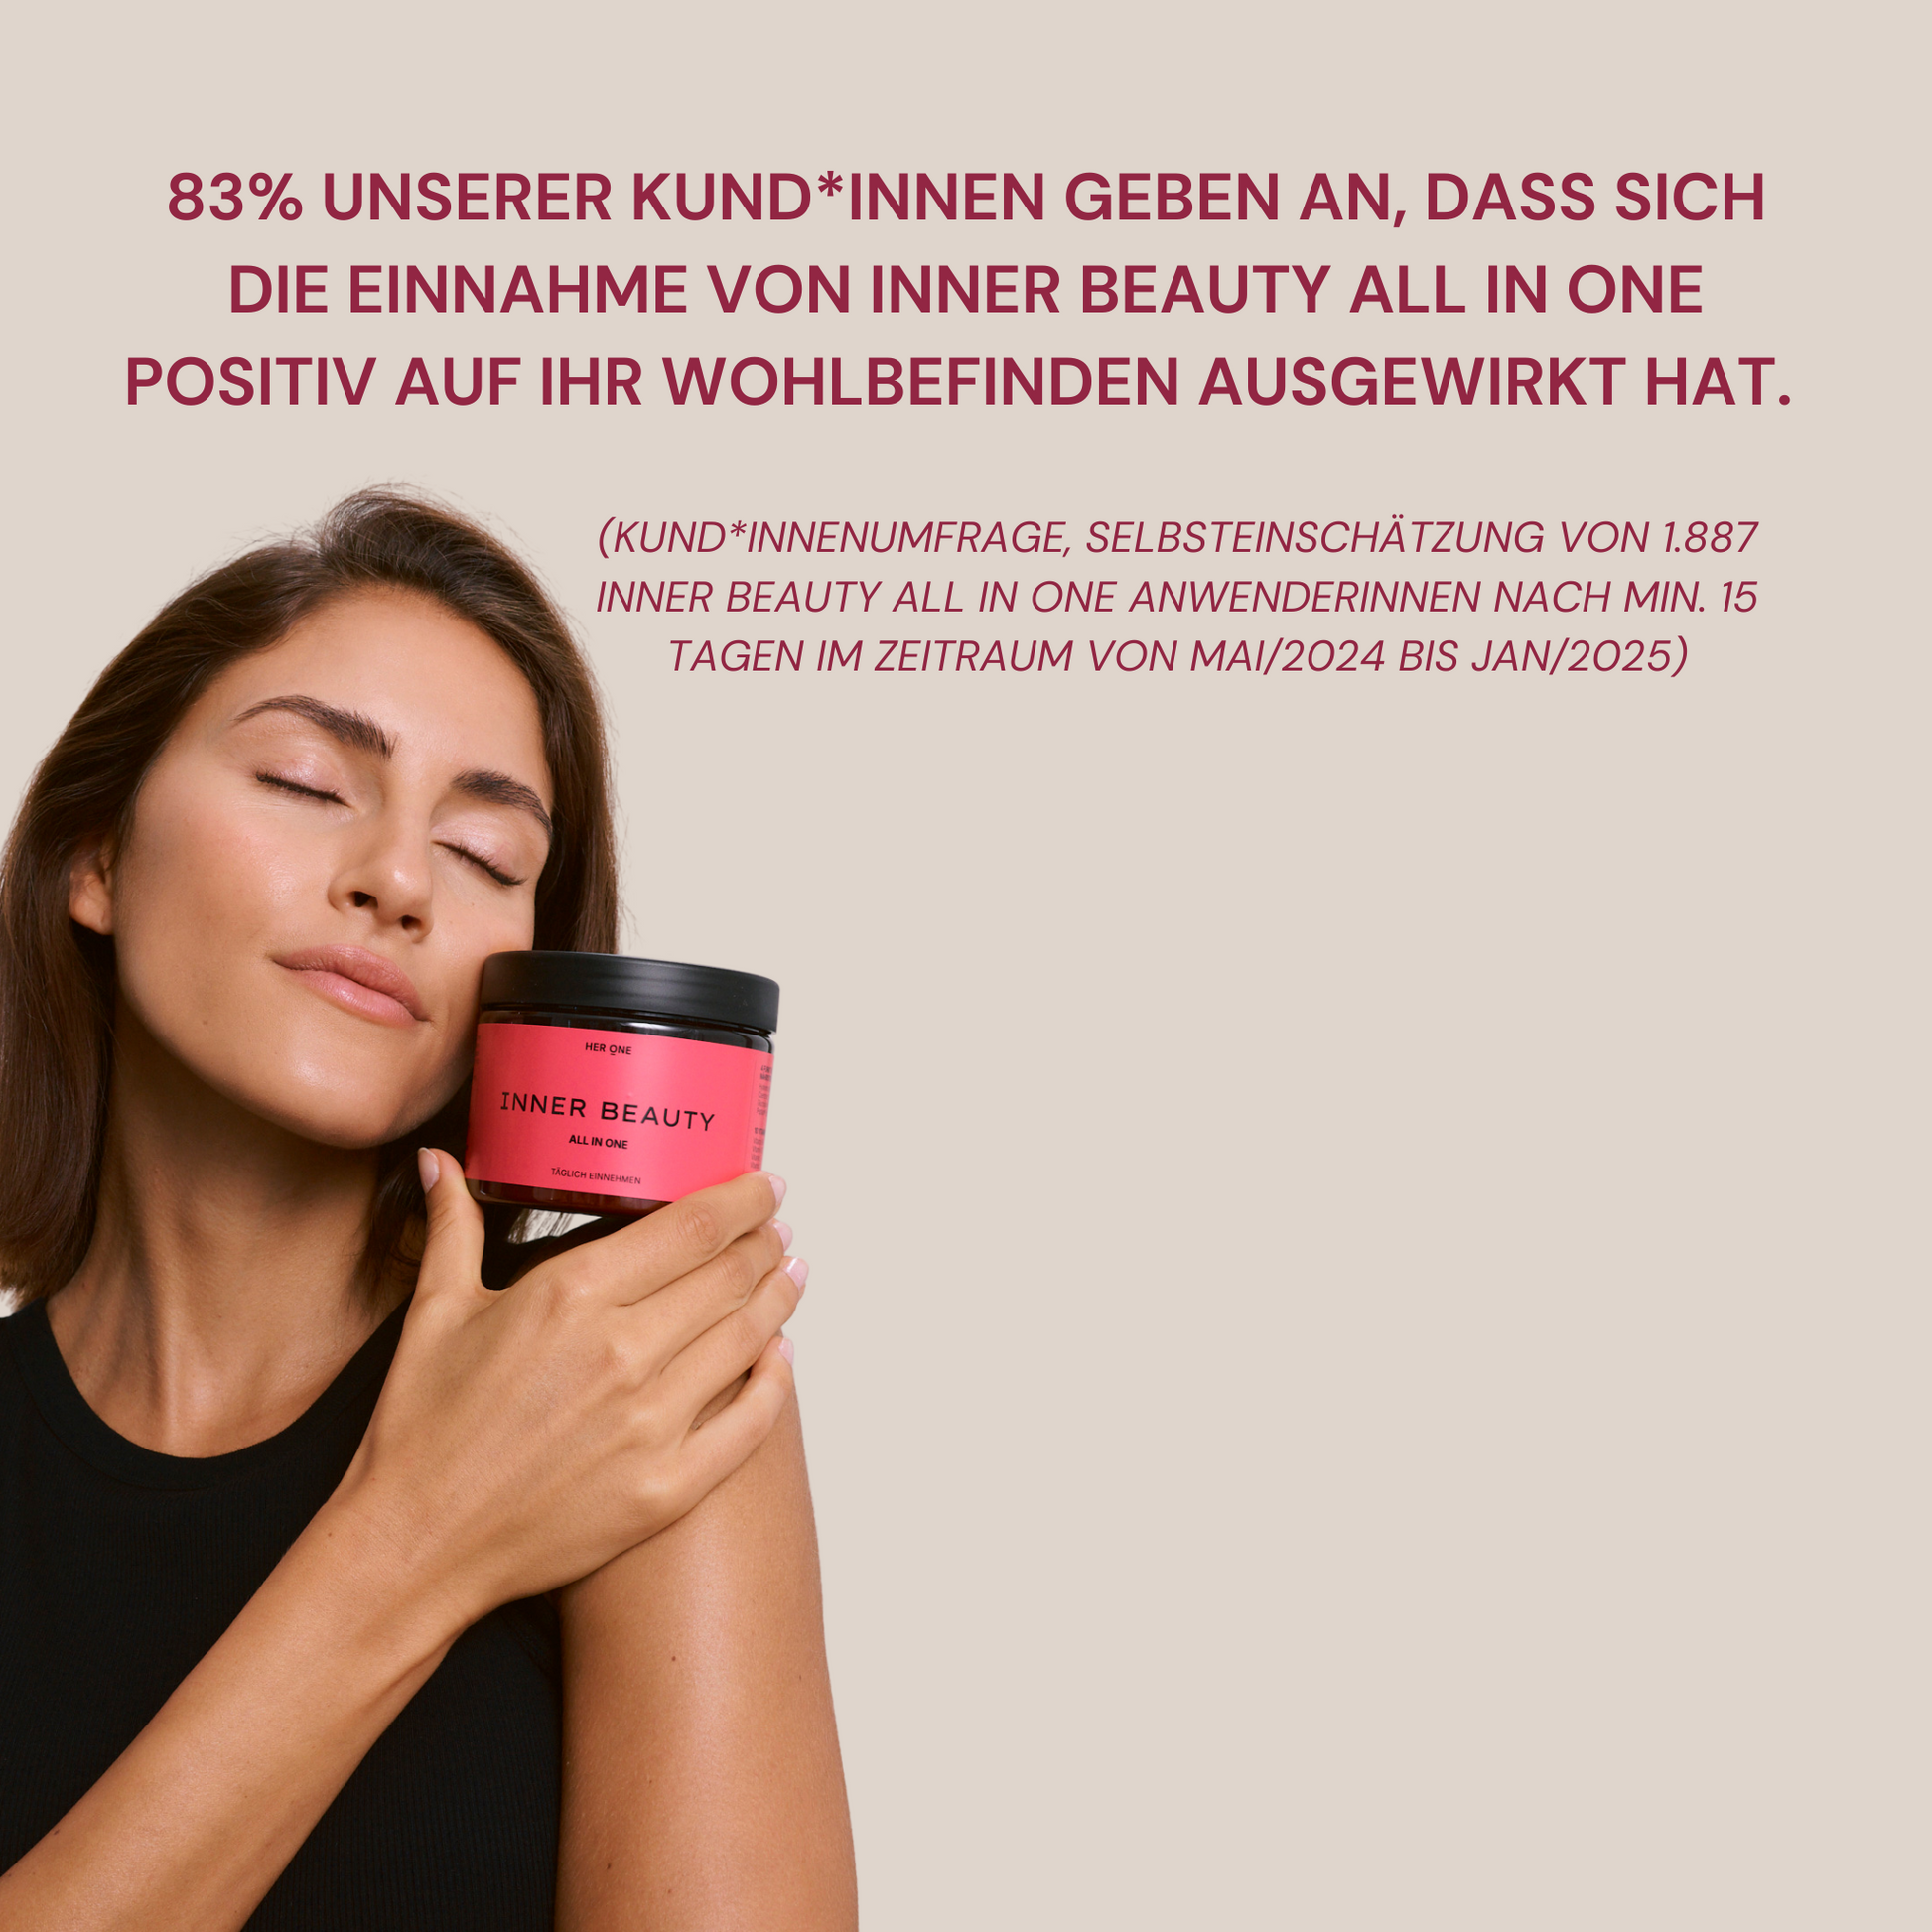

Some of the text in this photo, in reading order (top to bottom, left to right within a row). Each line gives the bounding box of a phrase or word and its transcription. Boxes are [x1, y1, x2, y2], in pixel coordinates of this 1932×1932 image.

[585, 1042, 632, 1056] HER ONE
[500, 1092, 715, 1132] INNER BEAUTY
[569, 1134, 628, 1150] ALL IN ONE
[551, 1167, 641, 1185] TÄGLICH EINNEHMEN
